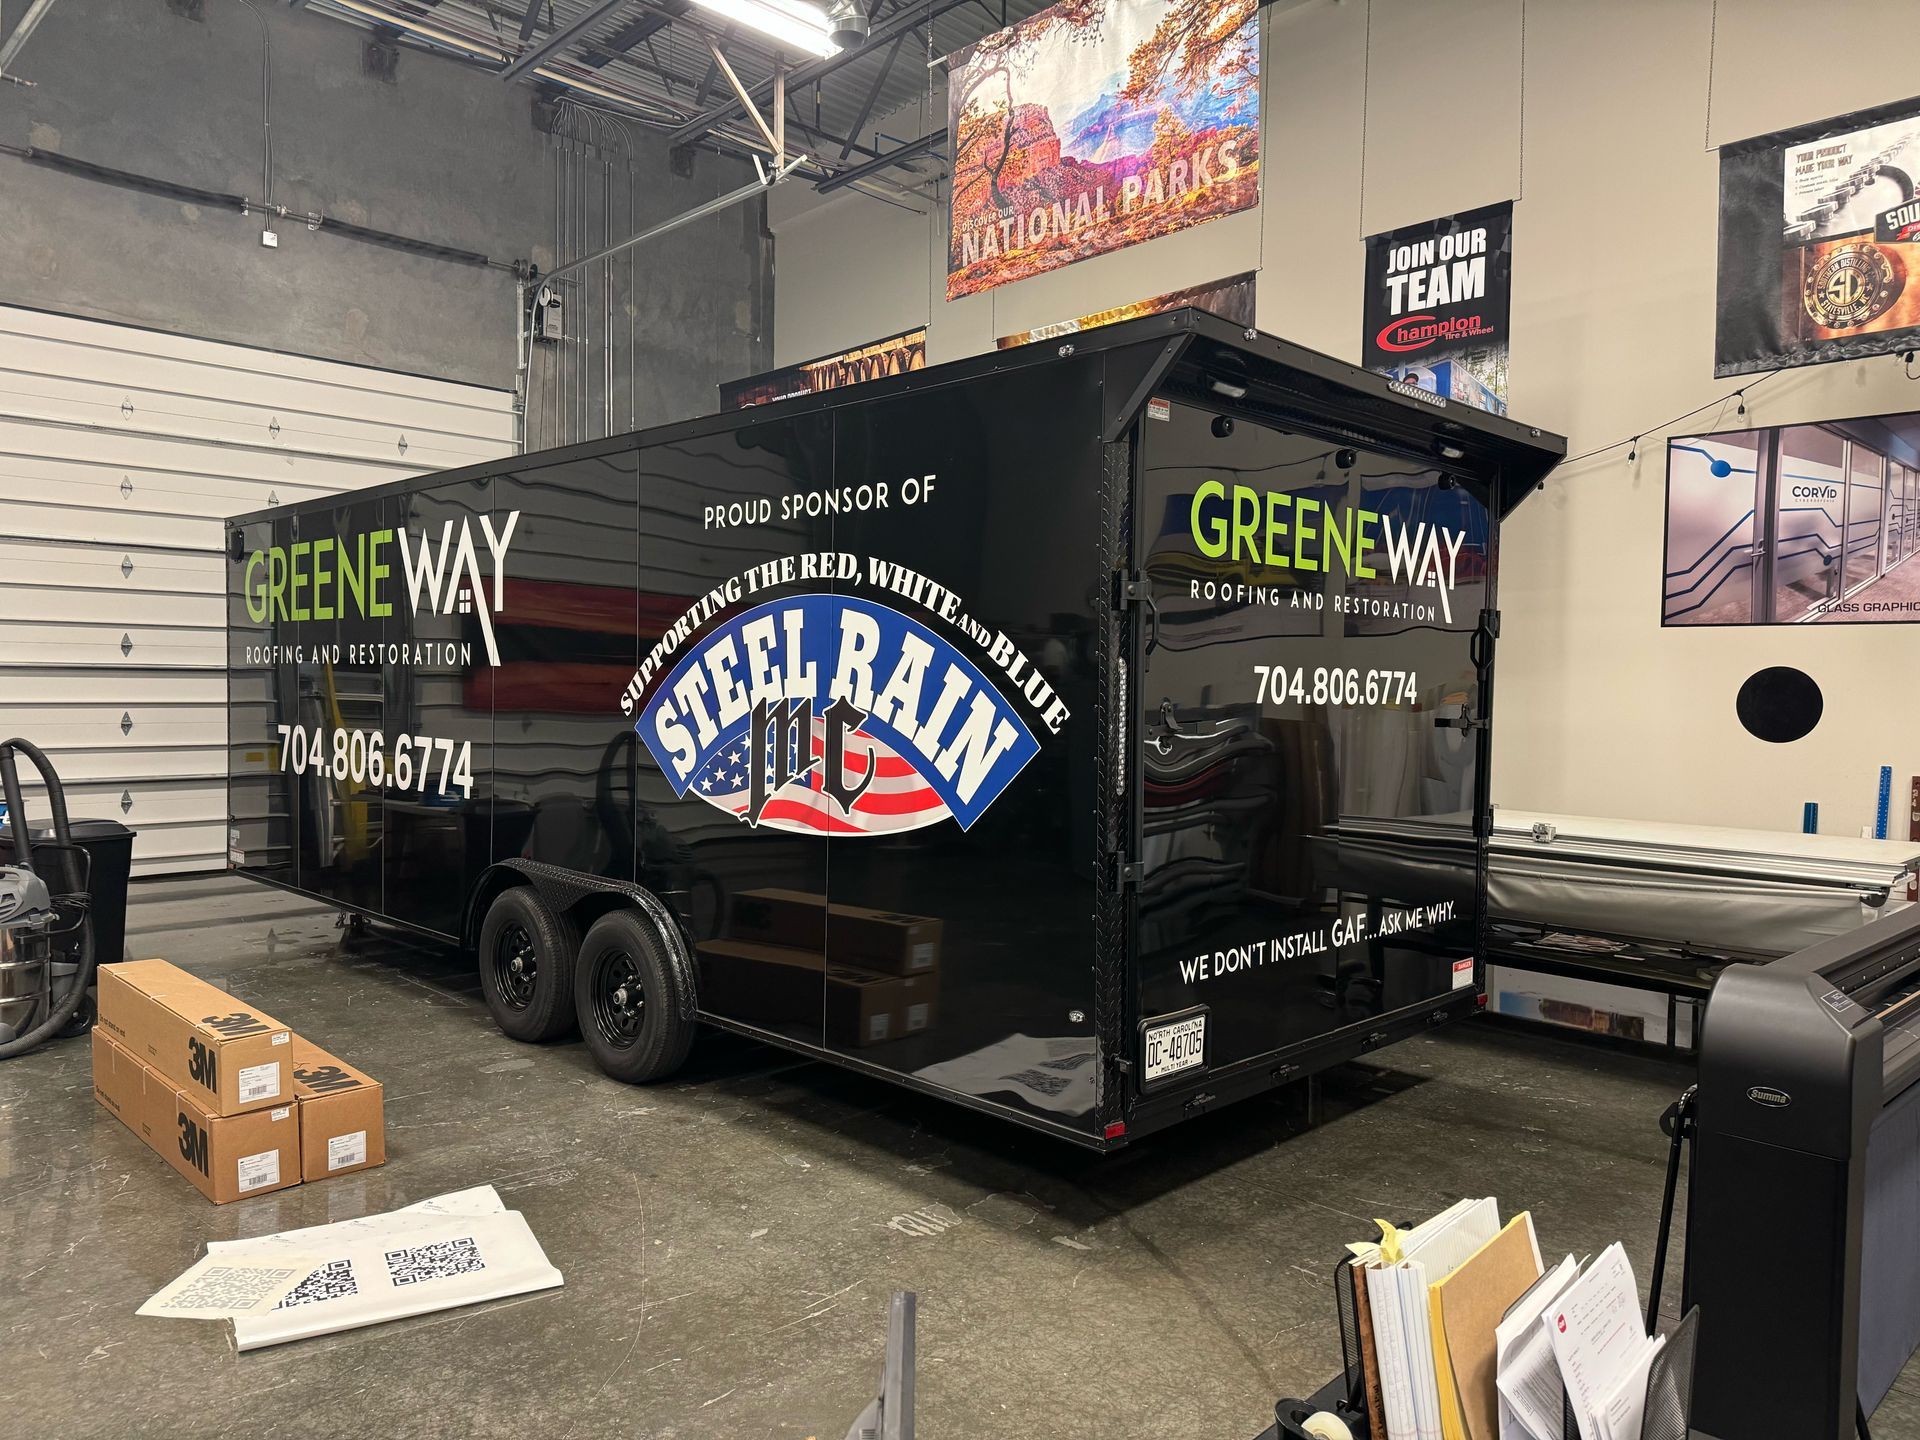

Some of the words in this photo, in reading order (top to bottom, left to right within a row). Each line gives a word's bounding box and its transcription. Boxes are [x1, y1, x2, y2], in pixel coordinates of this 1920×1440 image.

[962, 185, 1110, 267] NATIONAL
[1122, 140, 1239, 213] PARKS
[998, 206, 1014, 219] OUR
[1387, 240, 1434, 274] JOIN
[1440, 227, 1486, 261] OUR
[1386, 256, 1486, 316] TEAM
[1818, 261, 1840, 289] SOUTHERN
[1861, 293, 1870, 305] NC
[1376, 315, 1481, 352] Champion
[1469, 325, 1494, 337] Wheel
[704, 499, 771, 530] PROUD
[781, 481, 889, 521] SPONSOR
[901, 474, 937, 505] OF
[1190, 579, 1279, 606] ROOFING
[1290, 591, 1324, 611] AND
[1334, 595, 1436, 622] RESTORATION
[1818, 603, 1859, 613] GLASS
[246, 645, 303, 665] ROOFING
[312, 644, 340, 665] AND
[349, 642, 471, 667] RESTORATION
[619, 577, 743, 718] SUPPORTING
[743, 555, 797, 592] THE
[800, 552, 864, 587] RED,
[868, 556, 962, 623] WHITE
[956, 614, 993, 648] AND
[988, 629, 1071, 736] BLUE
[1254, 665, 1417, 705] 704.806.6774
[654, 608, 818, 783] STEEL
[829, 607, 1019, 807] RAIN
[278, 724, 474, 800] 704.806.6774
[1179, 956, 1209, 985] WE
[1215, 940, 1266, 978] DON'T
[1271, 929, 1328, 963] INSTALL
[1405, 907, 1423, 930] ME
[1426, 900, 1457, 925] WHY.
[202, 1013, 271, 1037] 3M
[1148, 1029, 1170, 1041] NORTH
[1172, 1020, 1203, 1035] CAROLINA
[188, 1037, 217, 1094] 3M
[1148, 1029, 1203, 1068] DC-48705
[294, 1066, 363, 1093] 3M
[1751, 1089, 1787, 1104] Summa
[177, 1112, 209, 1178] 3M
